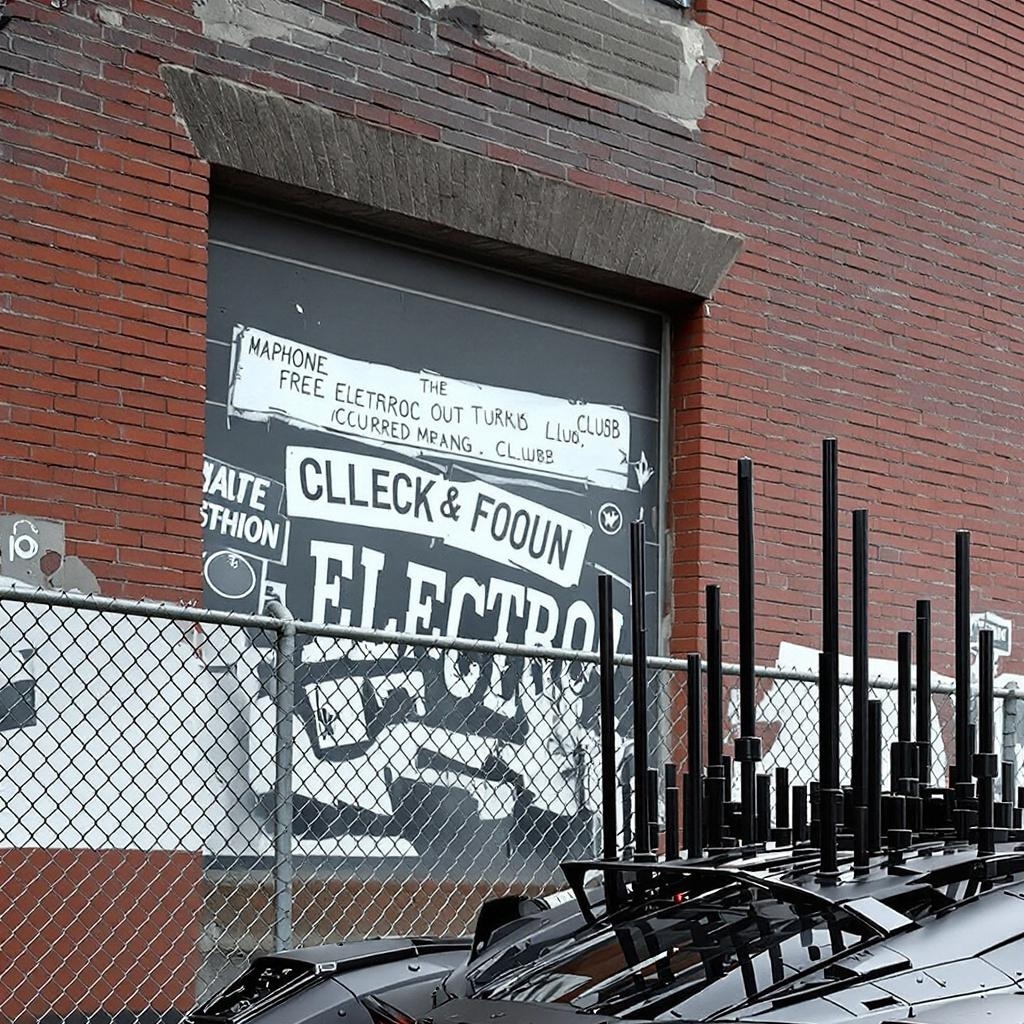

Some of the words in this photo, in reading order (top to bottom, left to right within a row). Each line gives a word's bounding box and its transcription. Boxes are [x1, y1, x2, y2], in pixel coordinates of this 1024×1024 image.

[248, 335, 329, 376] MAPHONE
[279, 369, 325, 399] FREE
[430, 403, 464, 424] OUT
[419, 378, 449, 396] THE
[299, 457, 436, 523] CLLECK
[439, 486, 459, 522] &
[470, 492, 573, 571] FOOUN
